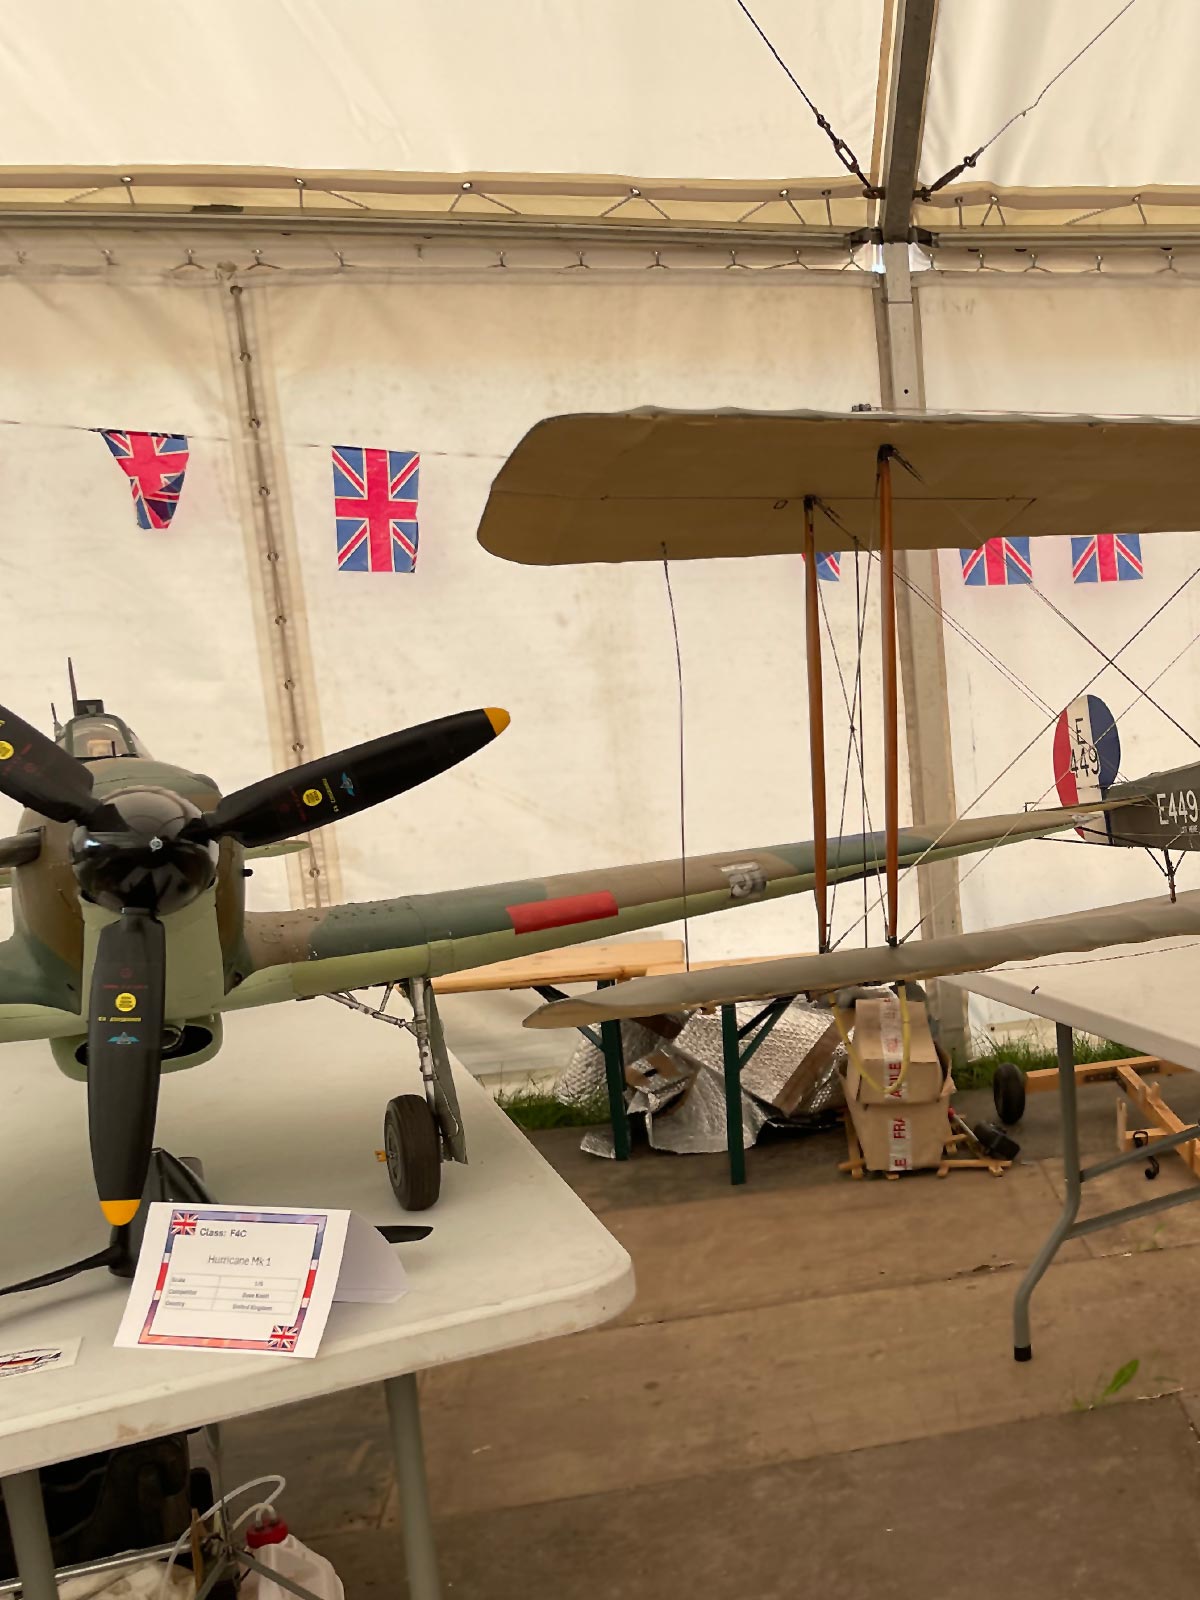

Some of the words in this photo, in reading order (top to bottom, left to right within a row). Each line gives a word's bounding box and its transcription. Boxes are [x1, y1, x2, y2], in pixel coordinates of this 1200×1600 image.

[1075, 717, 1087, 745] E
[1070, 747, 1100, 779] 449
[1156, 789, 1199, 825] E449
[199, 1228, 227, 1237] Class:
[230, 1229, 247, 1238] F4C
[208, 1255, 249, 1266] Hurricane
[250, 1256, 265, 1266] Mk
[265, 1257, 271, 1266] 1
